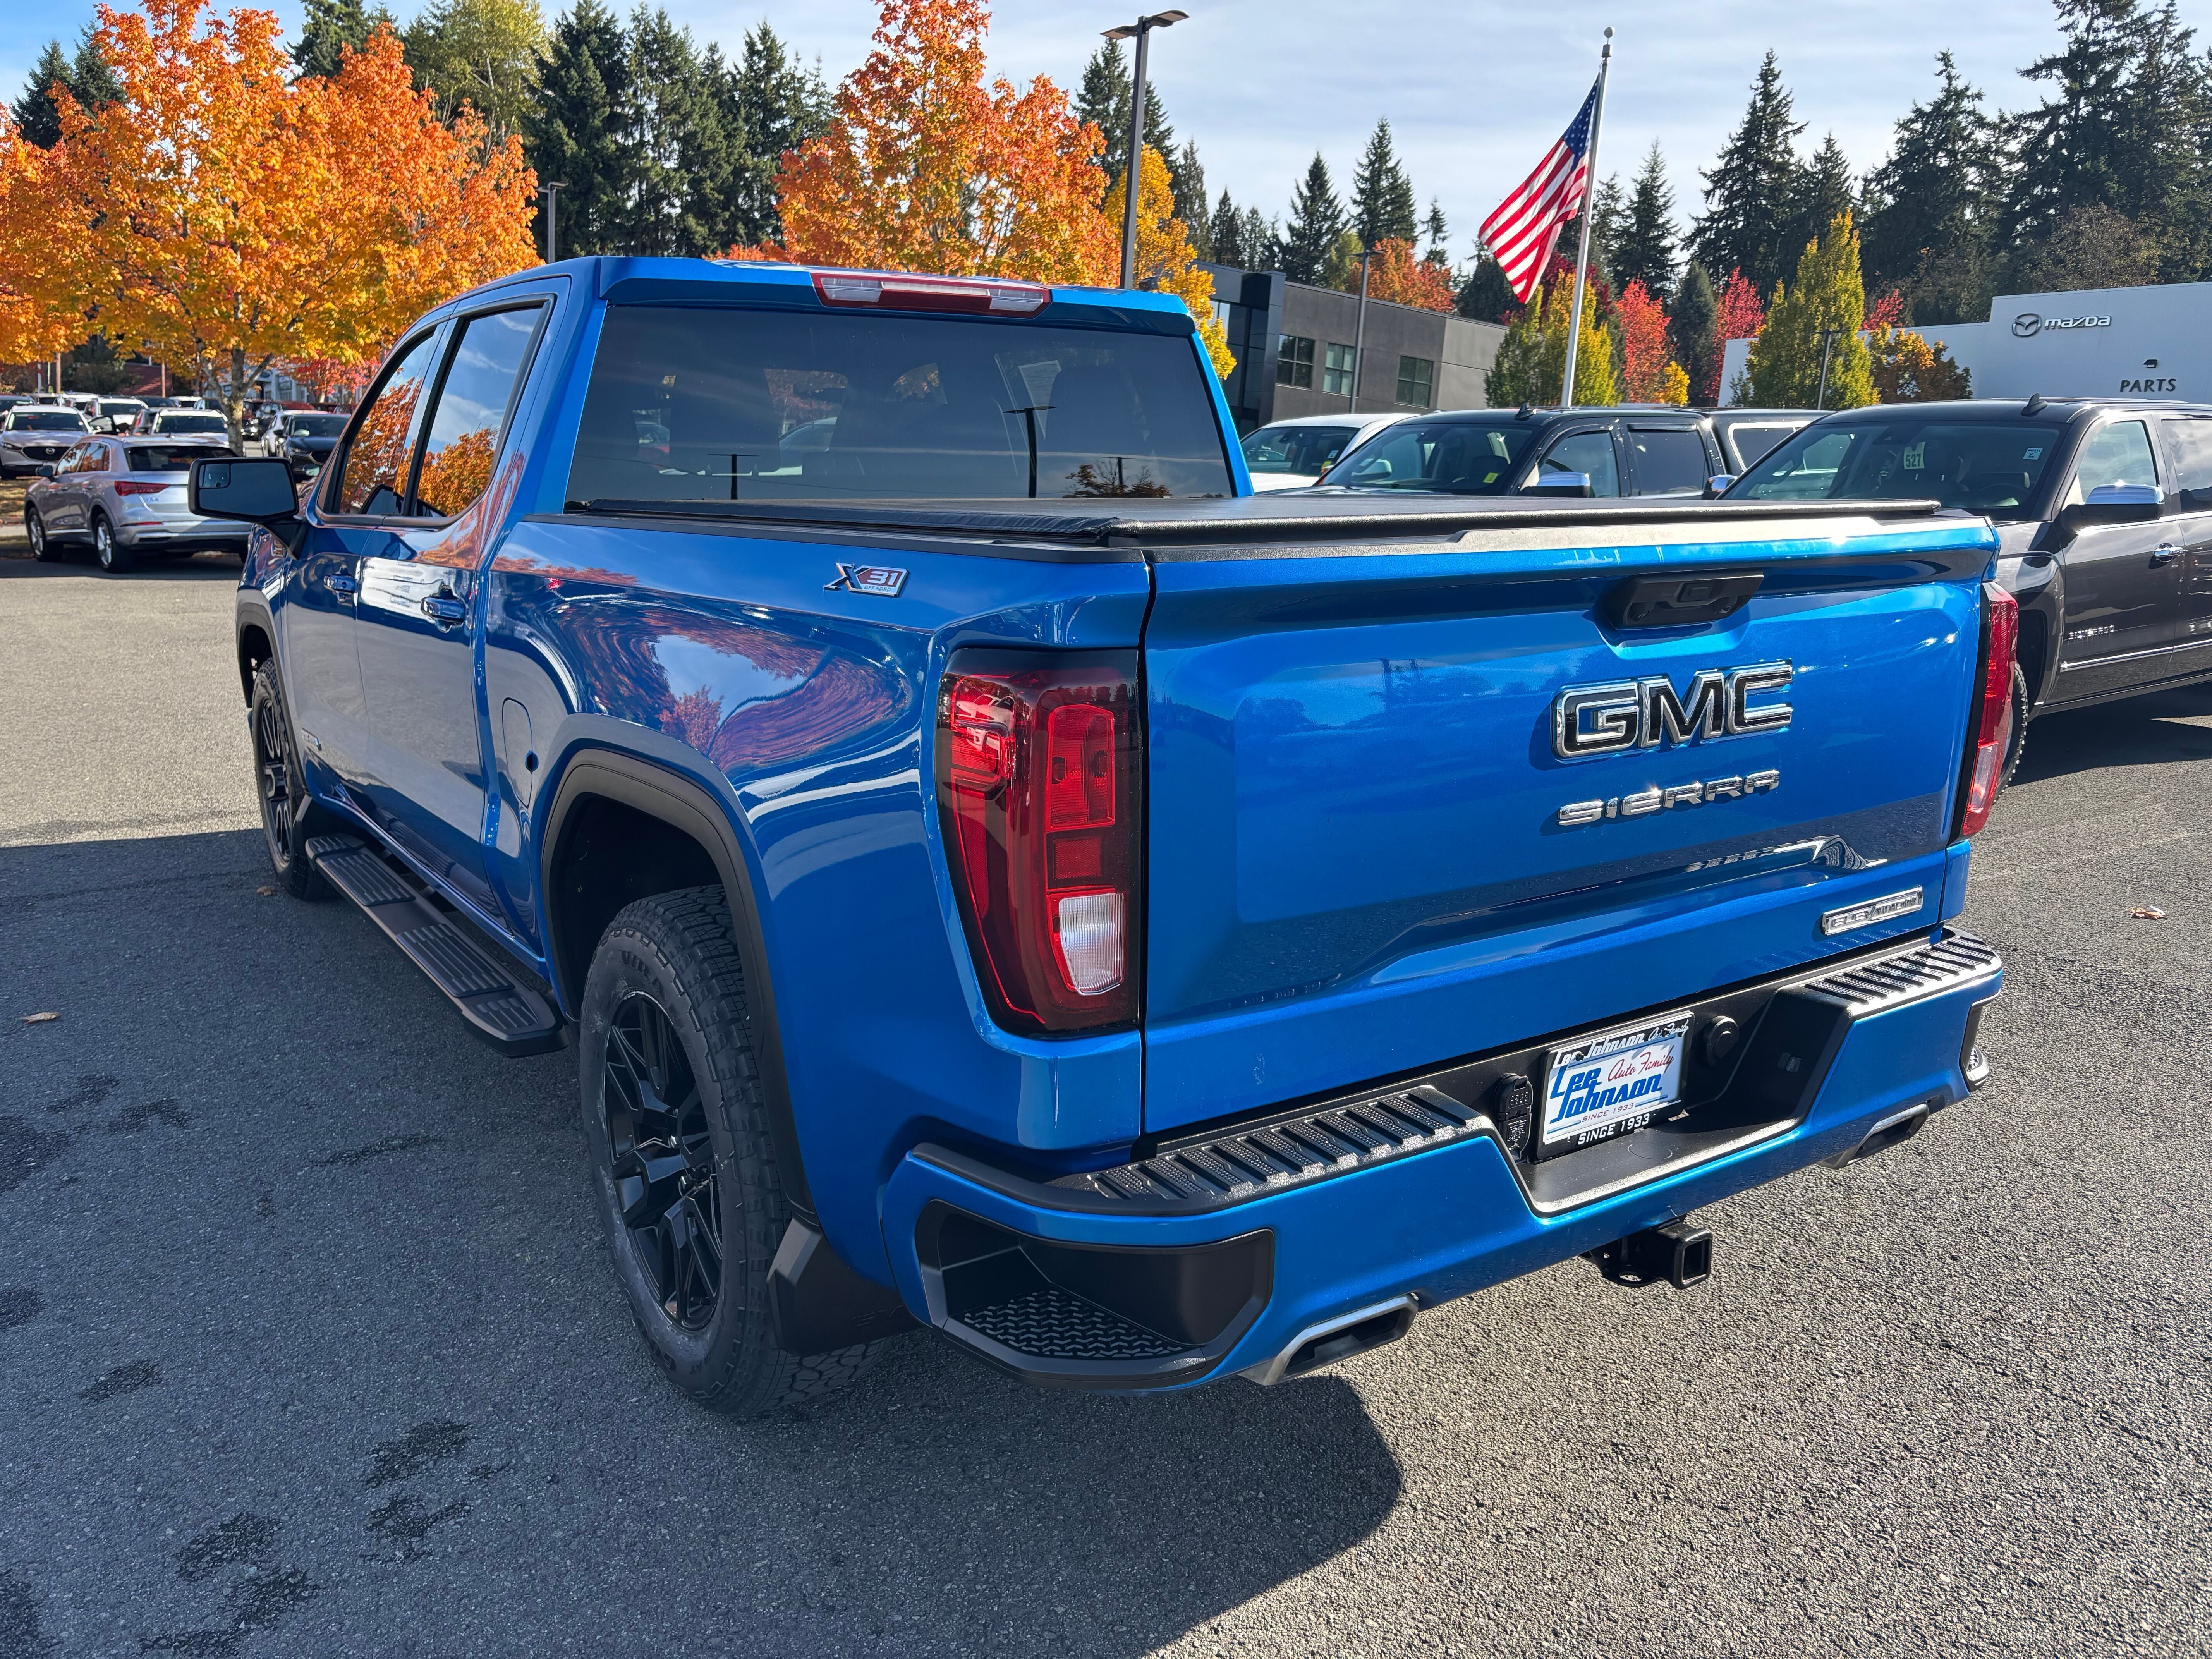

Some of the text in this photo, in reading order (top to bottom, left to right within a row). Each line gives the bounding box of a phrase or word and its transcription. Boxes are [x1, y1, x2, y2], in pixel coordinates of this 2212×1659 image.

[2119, 378, 2176, 392] PARTS
[1906, 453, 1922, 468] 527
[823, 562, 900, 592] X31
[1551, 659, 1794, 760] GMC
[1556, 769, 1780, 826] SIERRA
[1832, 895, 1917, 927] ELEVATION
[1584, 1037, 1645, 1059] Johnson
[1608, 1045, 1674, 1082] Auto Family
[1550, 1065, 1602, 1099] Lee
[1550, 1074, 1662, 1123] Johnson
[1582, 1103, 1634, 1122] SINCE 1933
[1578, 1113, 1650, 1145] SINCE 1933
